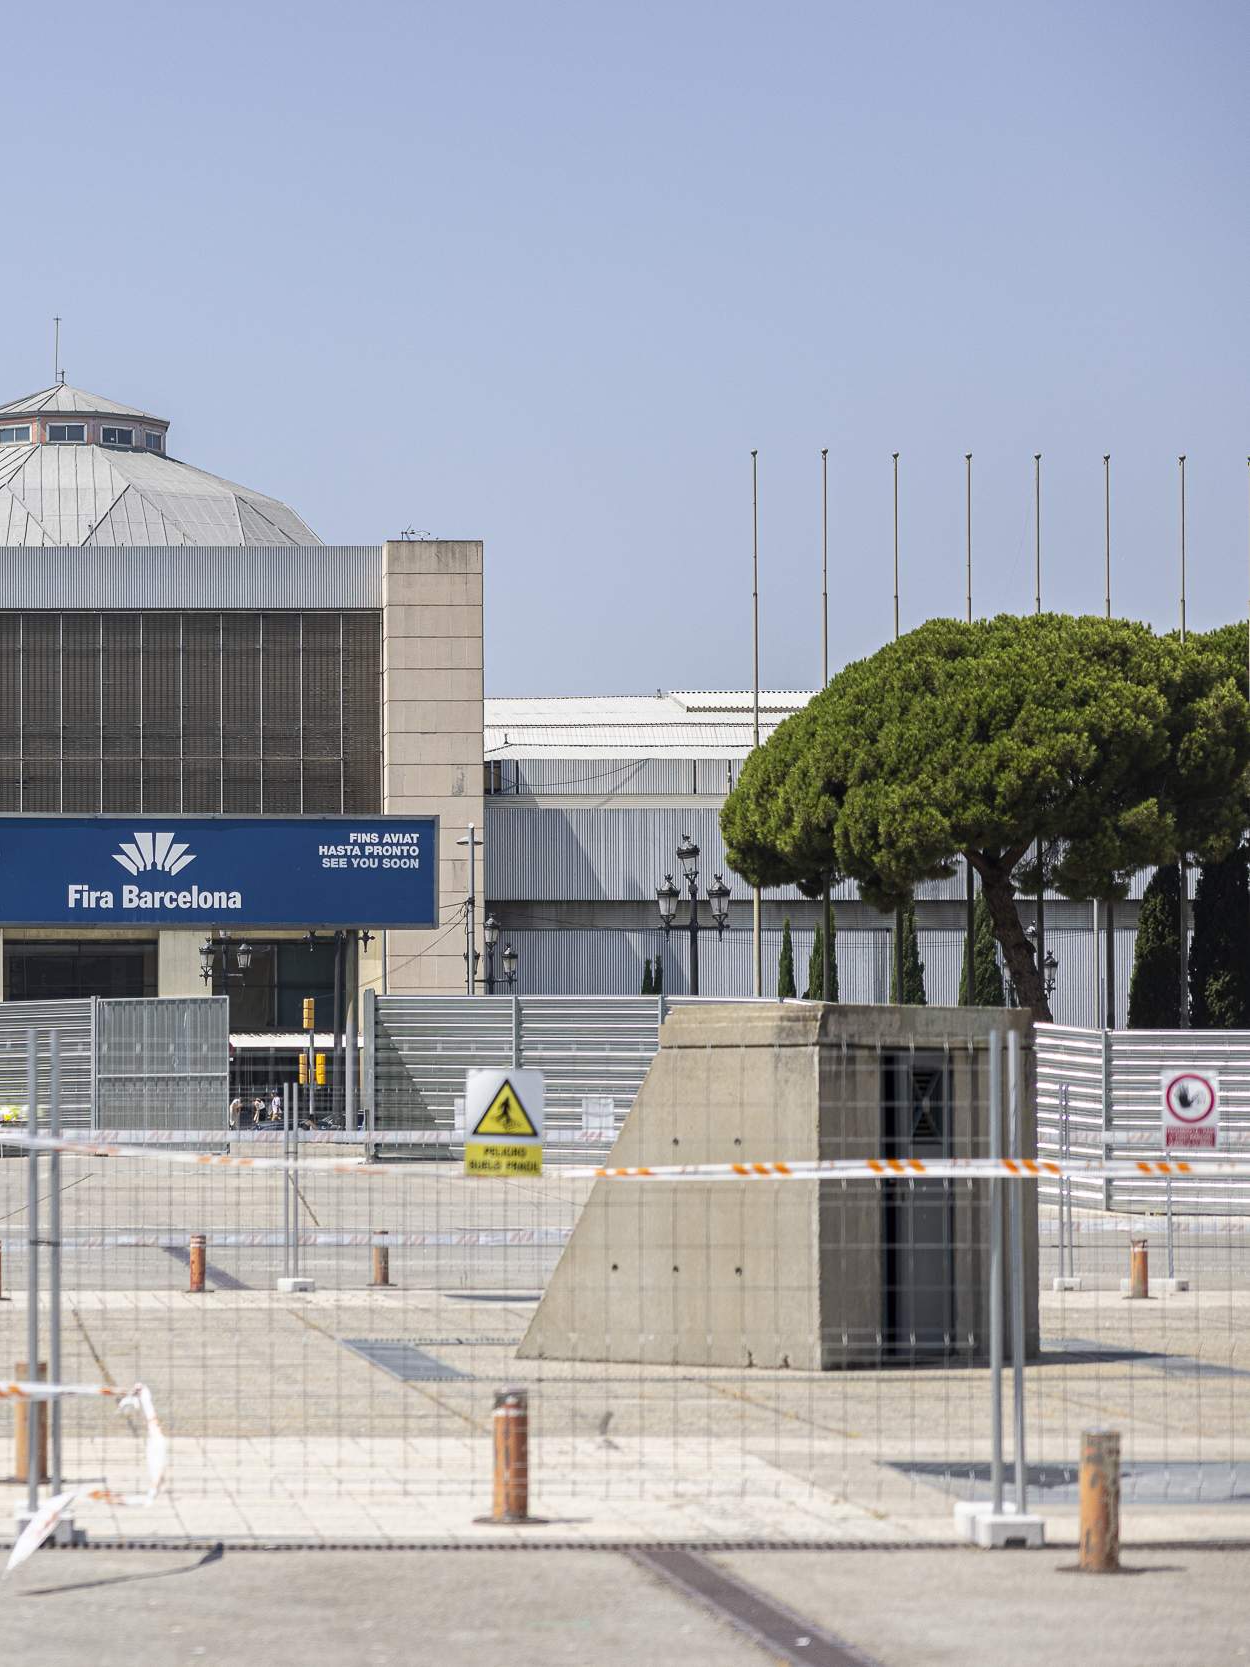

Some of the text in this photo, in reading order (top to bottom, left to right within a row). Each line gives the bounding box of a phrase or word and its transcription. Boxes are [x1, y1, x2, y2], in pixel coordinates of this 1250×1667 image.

[349, 833, 420, 844] FINS AVIAT
[318, 845, 420, 856] HASTA PRONTO
[321, 858, 419, 869] SEE YOU SOON
[68, 884, 242, 909] Fira Barcelona
